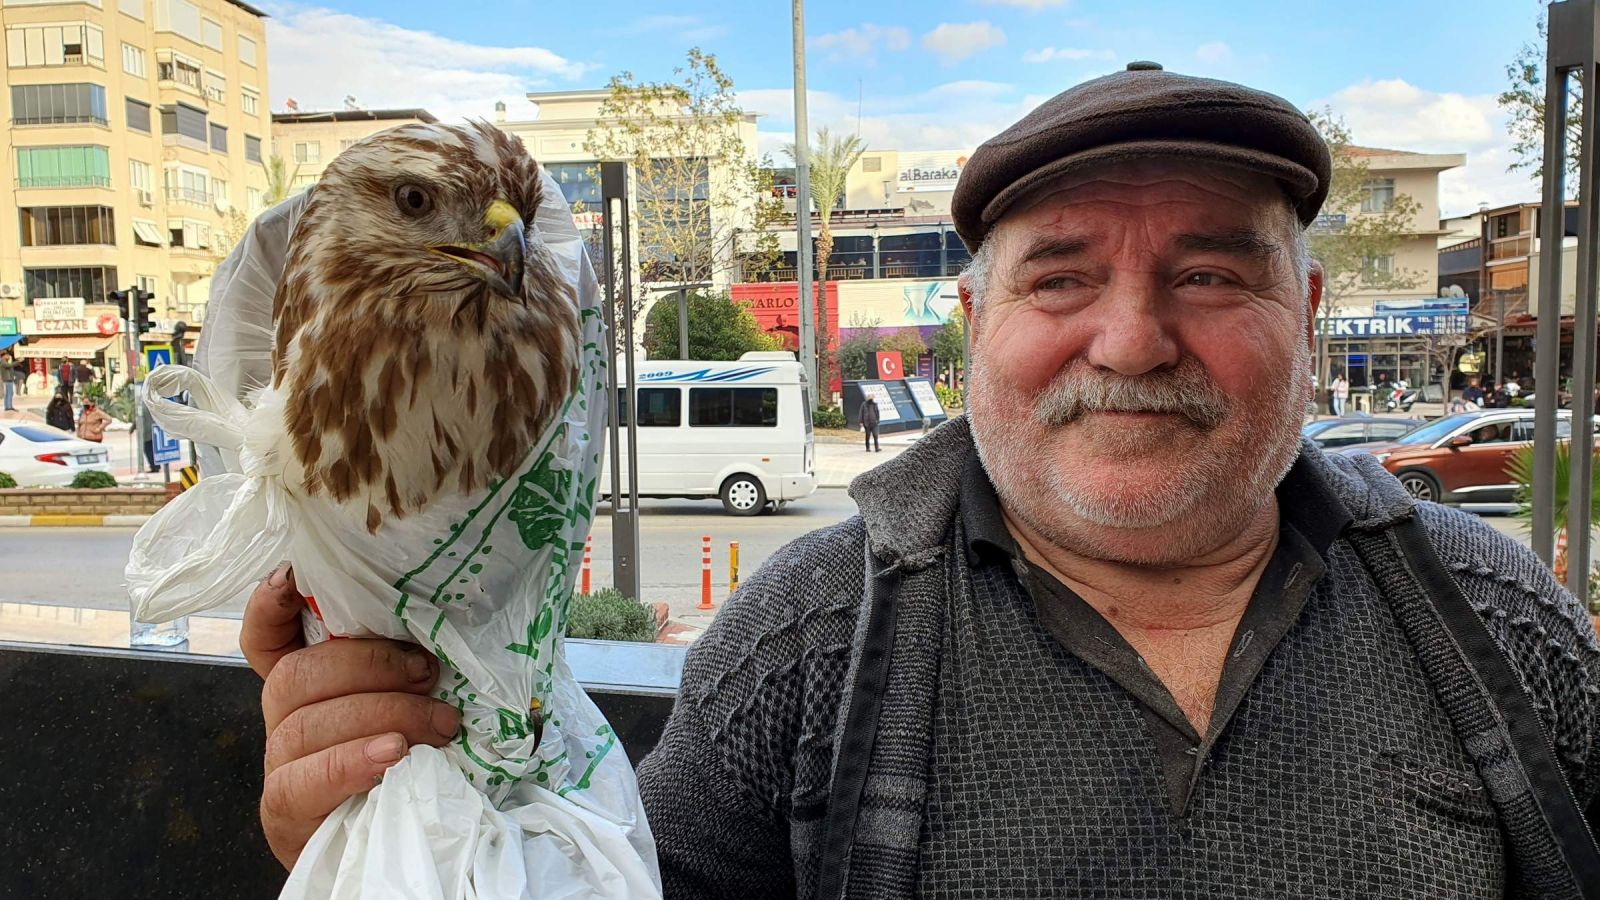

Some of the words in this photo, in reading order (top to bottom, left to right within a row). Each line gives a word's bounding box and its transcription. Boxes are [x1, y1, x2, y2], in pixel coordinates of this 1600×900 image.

[900, 168, 958, 181] alBaraka
[36, 319, 88, 331] ECZANE
[1314, 316, 1413, 335] EKTRİK
[639, 370, 673, 380] 2009
